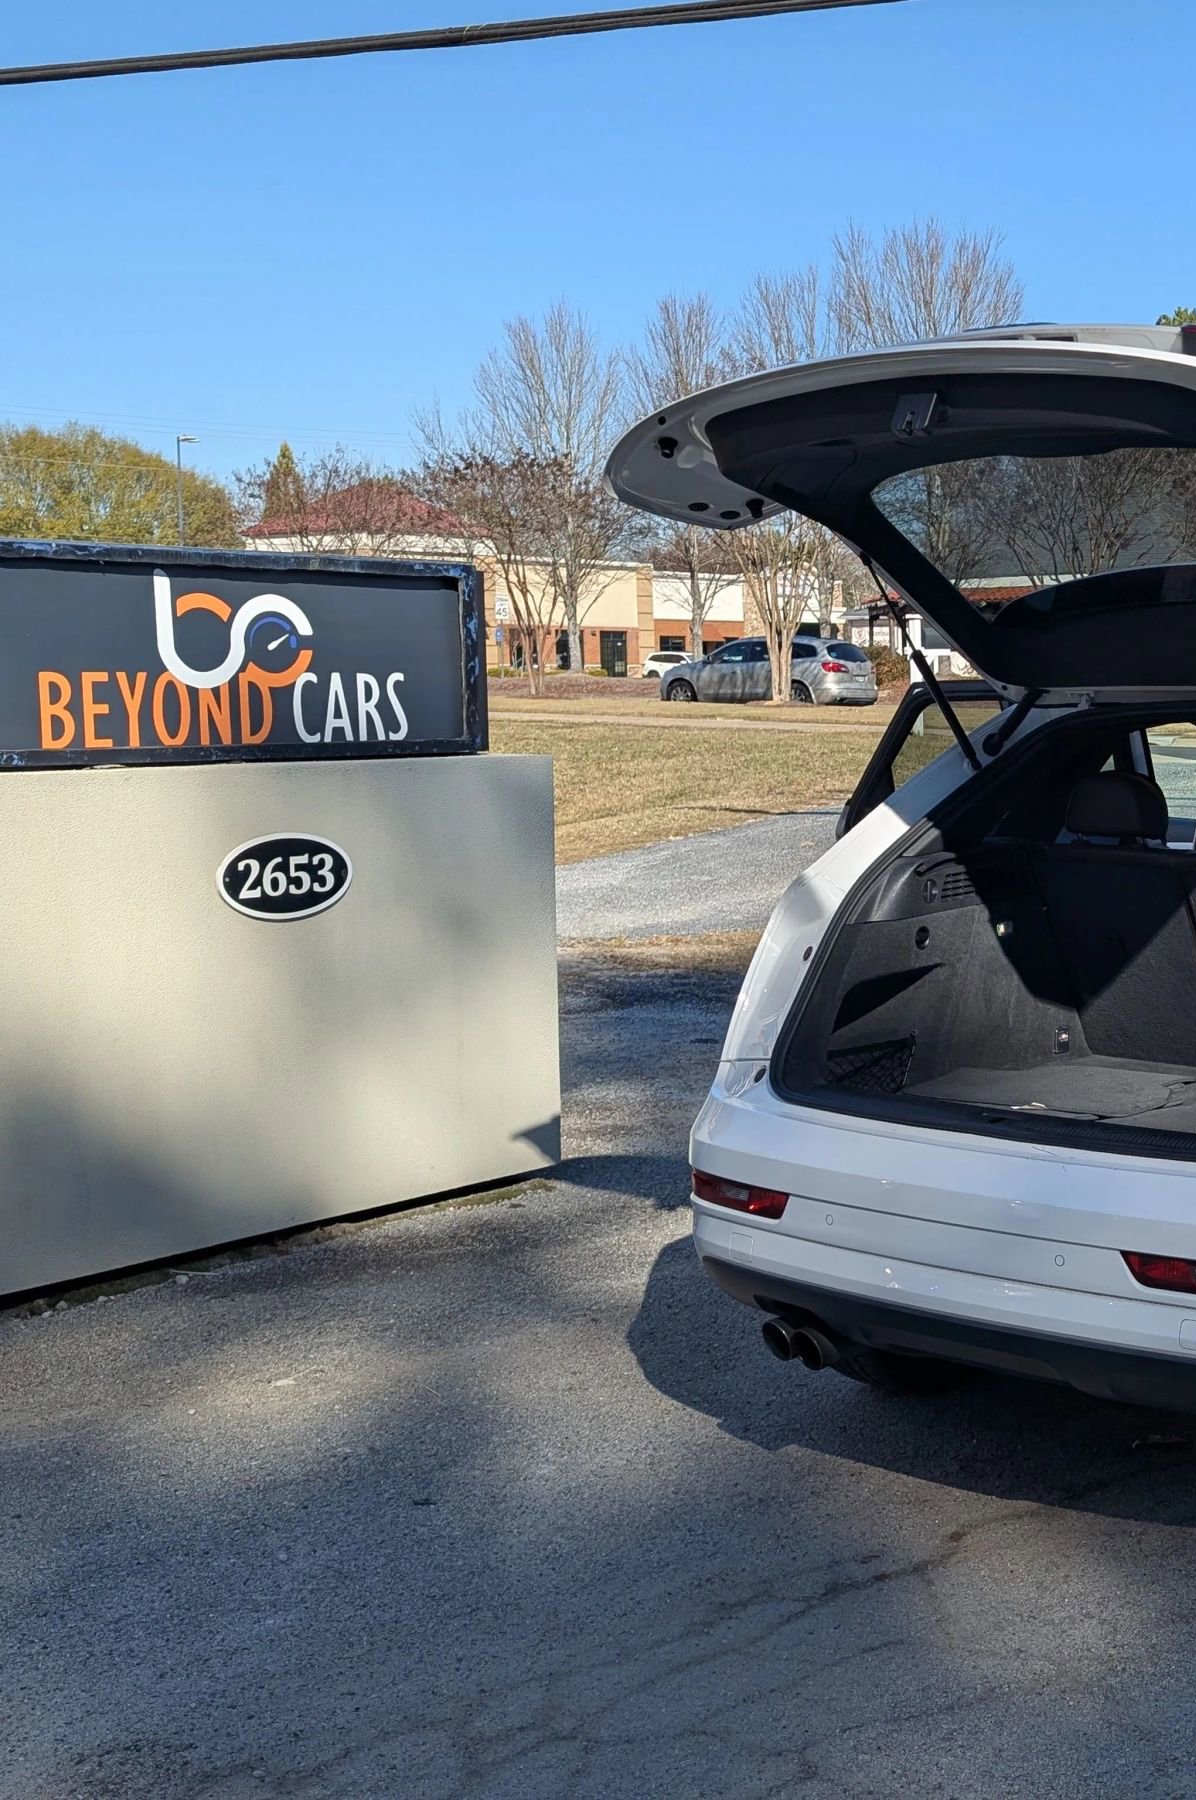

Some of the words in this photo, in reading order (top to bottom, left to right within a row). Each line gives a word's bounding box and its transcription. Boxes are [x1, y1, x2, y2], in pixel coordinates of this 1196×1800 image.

[496, 608, 507, 617] 45
[38, 671, 273, 749] BEYOND
[293, 672, 408, 743] CARS
[237, 853, 335, 900] 2653
